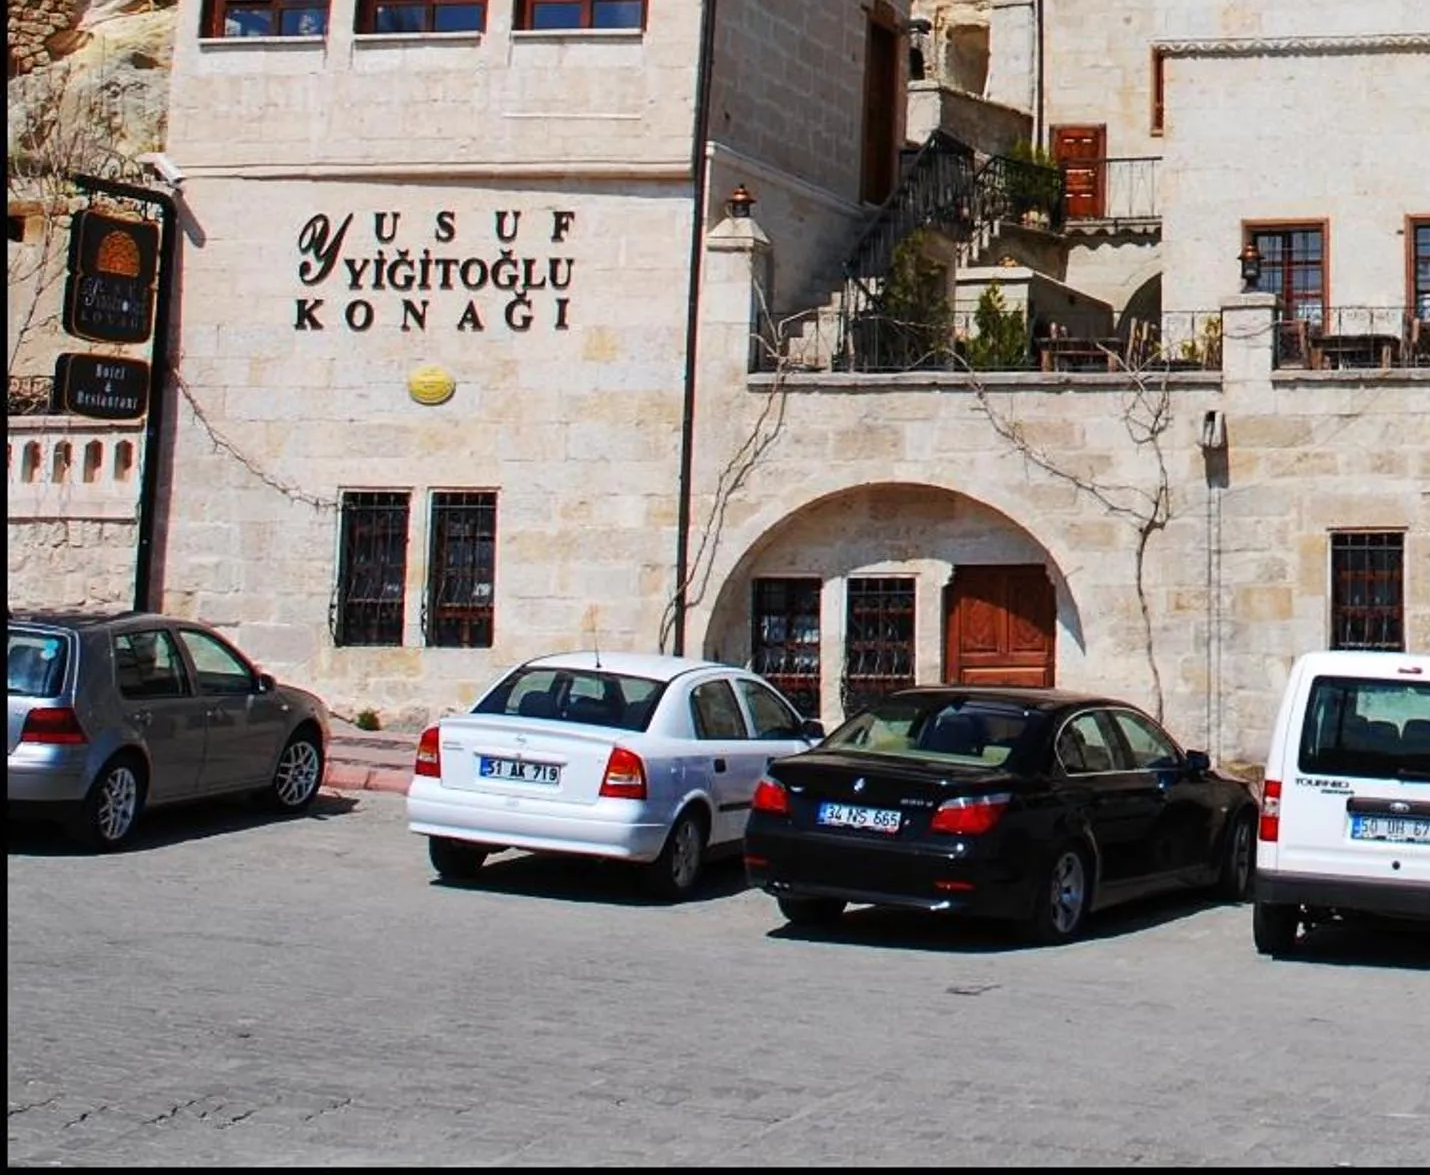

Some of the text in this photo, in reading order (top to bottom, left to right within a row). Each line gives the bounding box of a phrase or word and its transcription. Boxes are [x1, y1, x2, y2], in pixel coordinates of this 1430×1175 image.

[344, 249, 575, 291] YİĞİTOĞLU
[294, 290, 571, 332] KONAĞI
[510, 762, 525, 779] AK
[827, 805, 842, 819] 34
